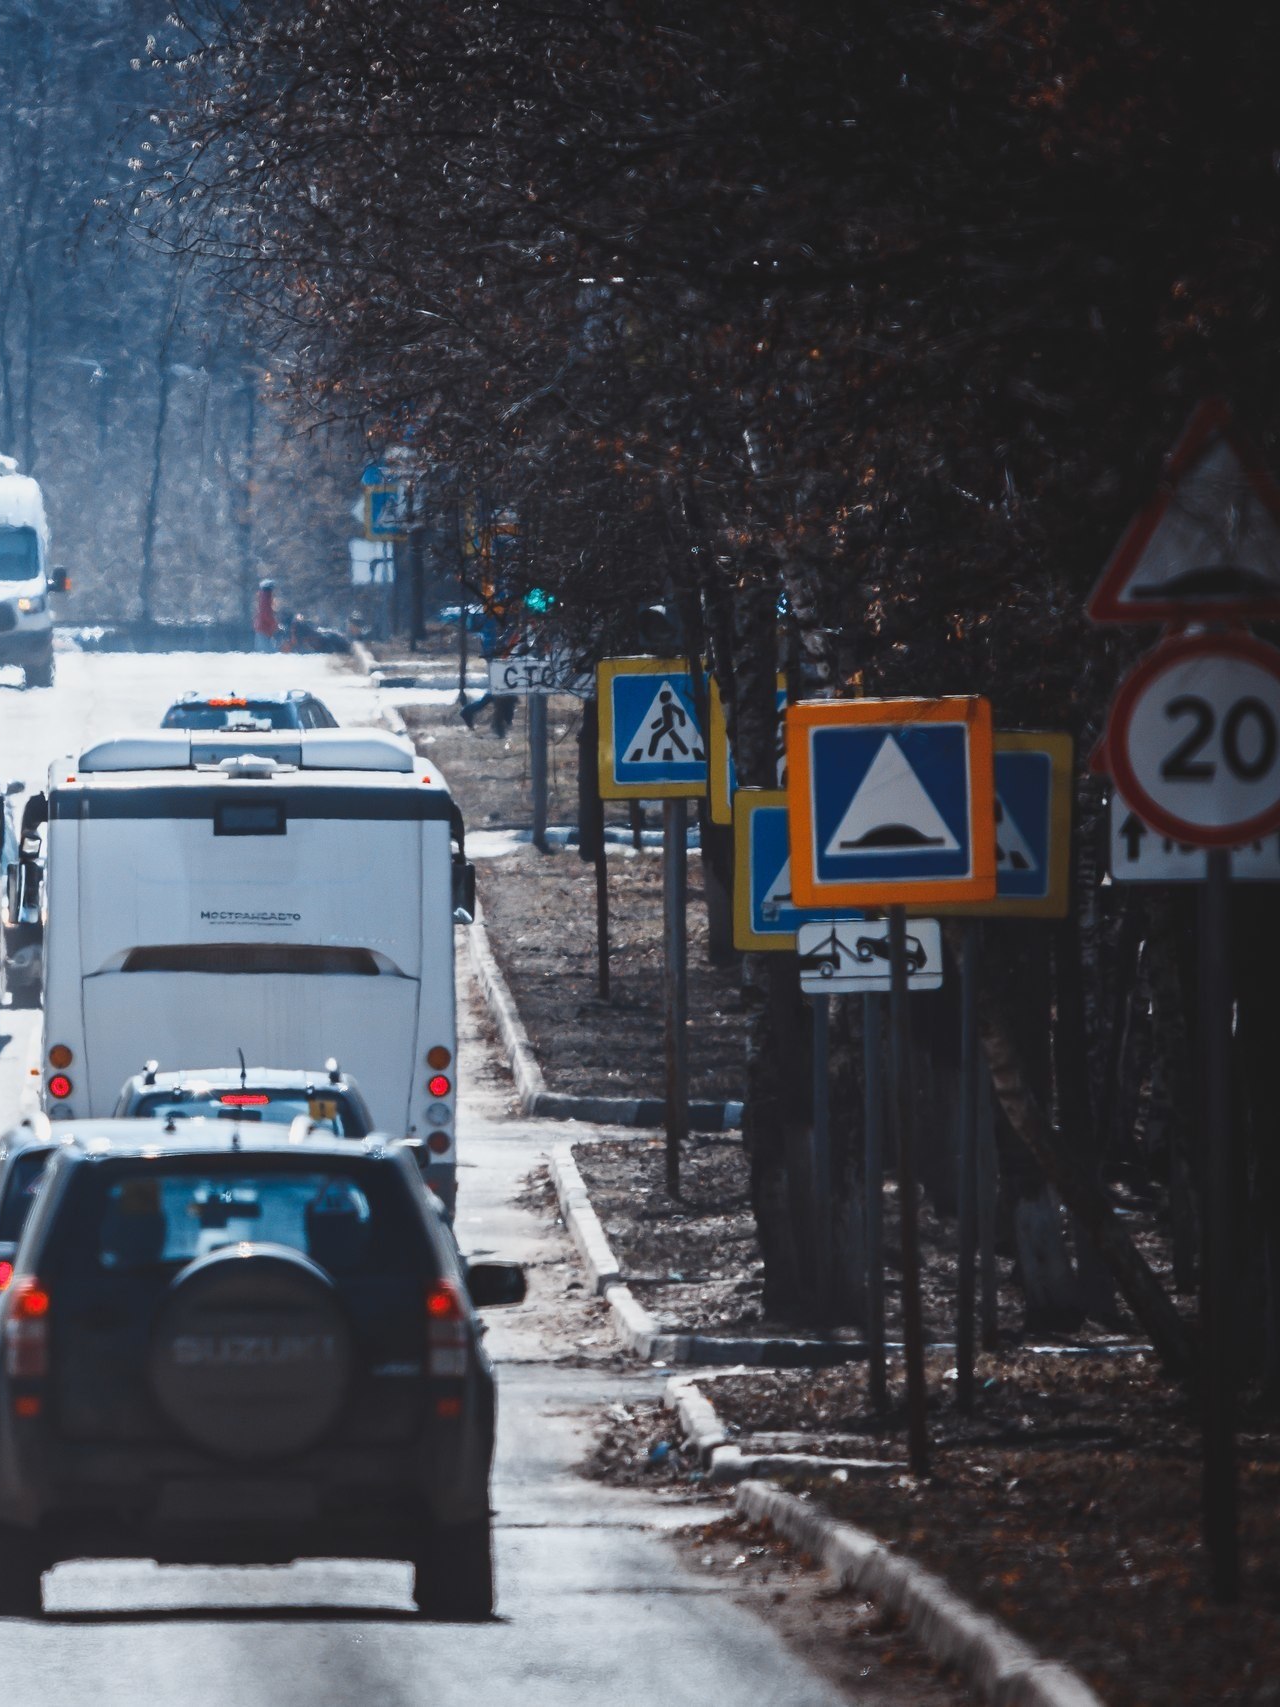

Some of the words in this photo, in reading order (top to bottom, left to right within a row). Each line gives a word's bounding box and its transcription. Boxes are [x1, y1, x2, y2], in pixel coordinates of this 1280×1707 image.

[504, 665, 577, 689] СТО
[1160, 694, 1276, 784] 20
[173, 1335, 336, 1364] SUZUKI
